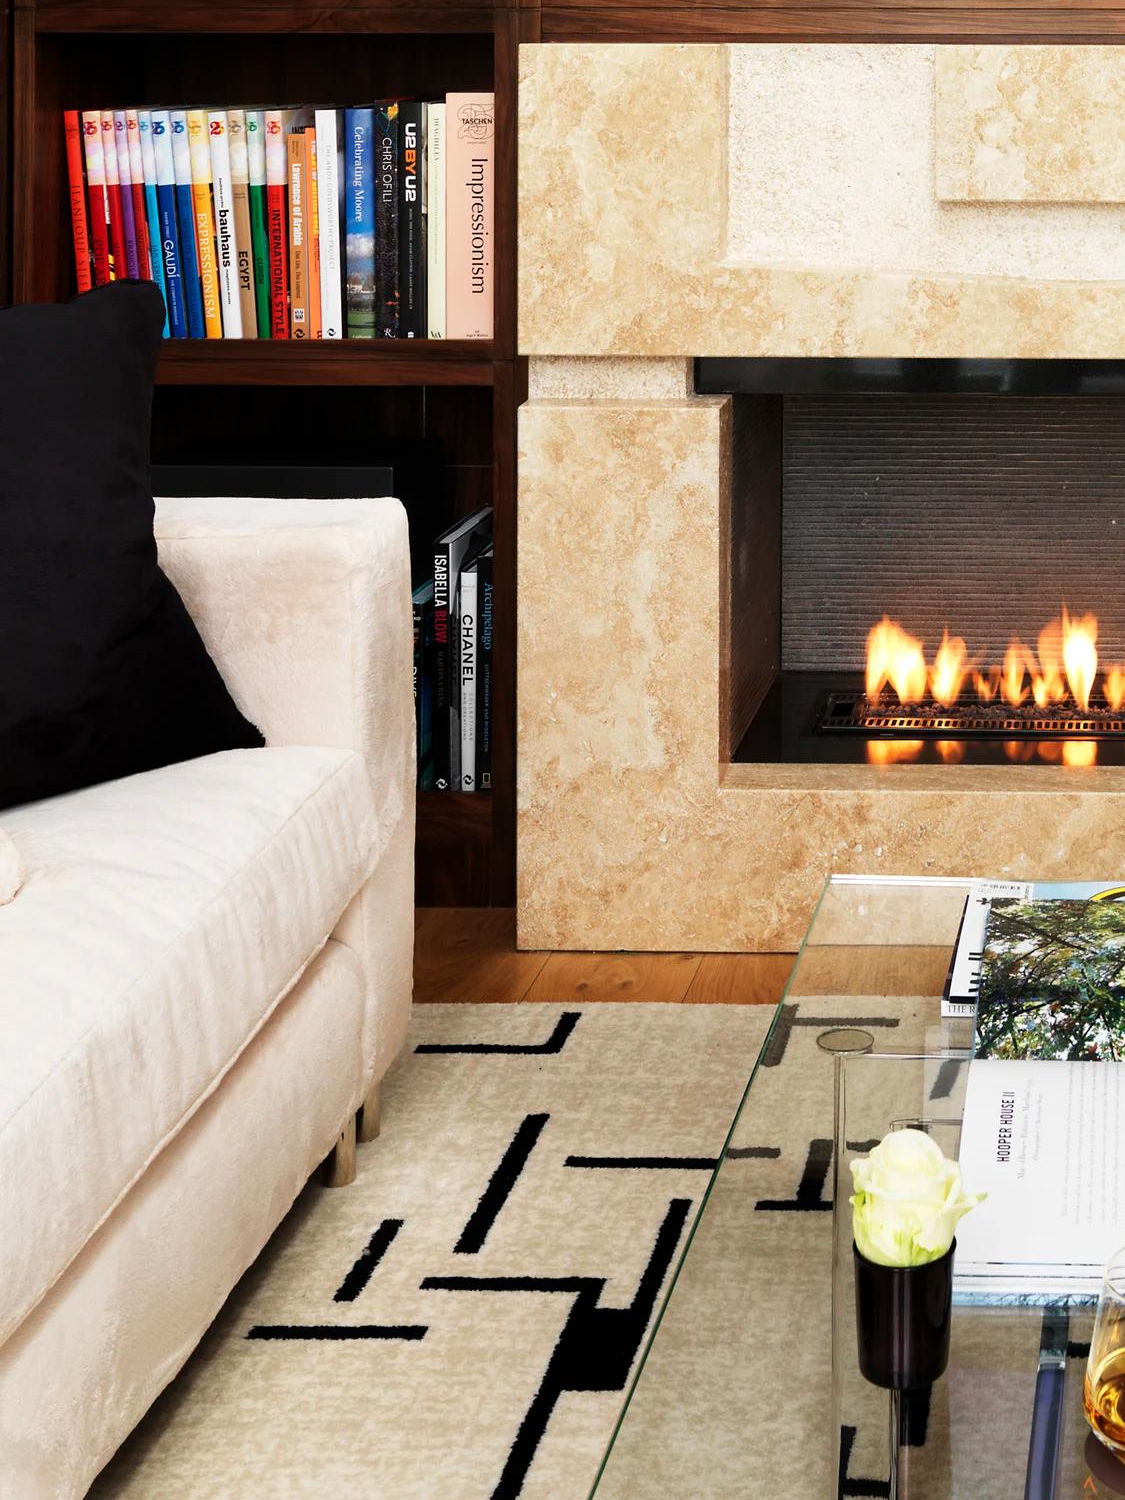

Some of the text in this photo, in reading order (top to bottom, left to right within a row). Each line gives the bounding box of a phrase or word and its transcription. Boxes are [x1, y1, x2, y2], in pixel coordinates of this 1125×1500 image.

[353, 126, 364, 222] Celebrating Moore
[382, 137, 392, 202] CHRIS OFILI
[219, 209, 232, 267] bauhaus
[292, 164, 303, 246] Lawrence of Arabia
[466, 158, 489, 294] Impressionism
[163, 240, 180, 278] GAUDÍ
[197, 213, 215, 318] EXPRESSIONISM
[238, 251, 250, 291] EGYPT
[271, 209, 284, 334] INTERNATIONAL STYLE
[434, 554, 447, 643] ISABELLA BLOW
[480, 582, 493, 650] Archipelago
[462, 615, 473, 685] CHANEL
[997, 1128, 1012, 1162] HOOPER
[1000, 1100, 1014, 1124] HOUSE
